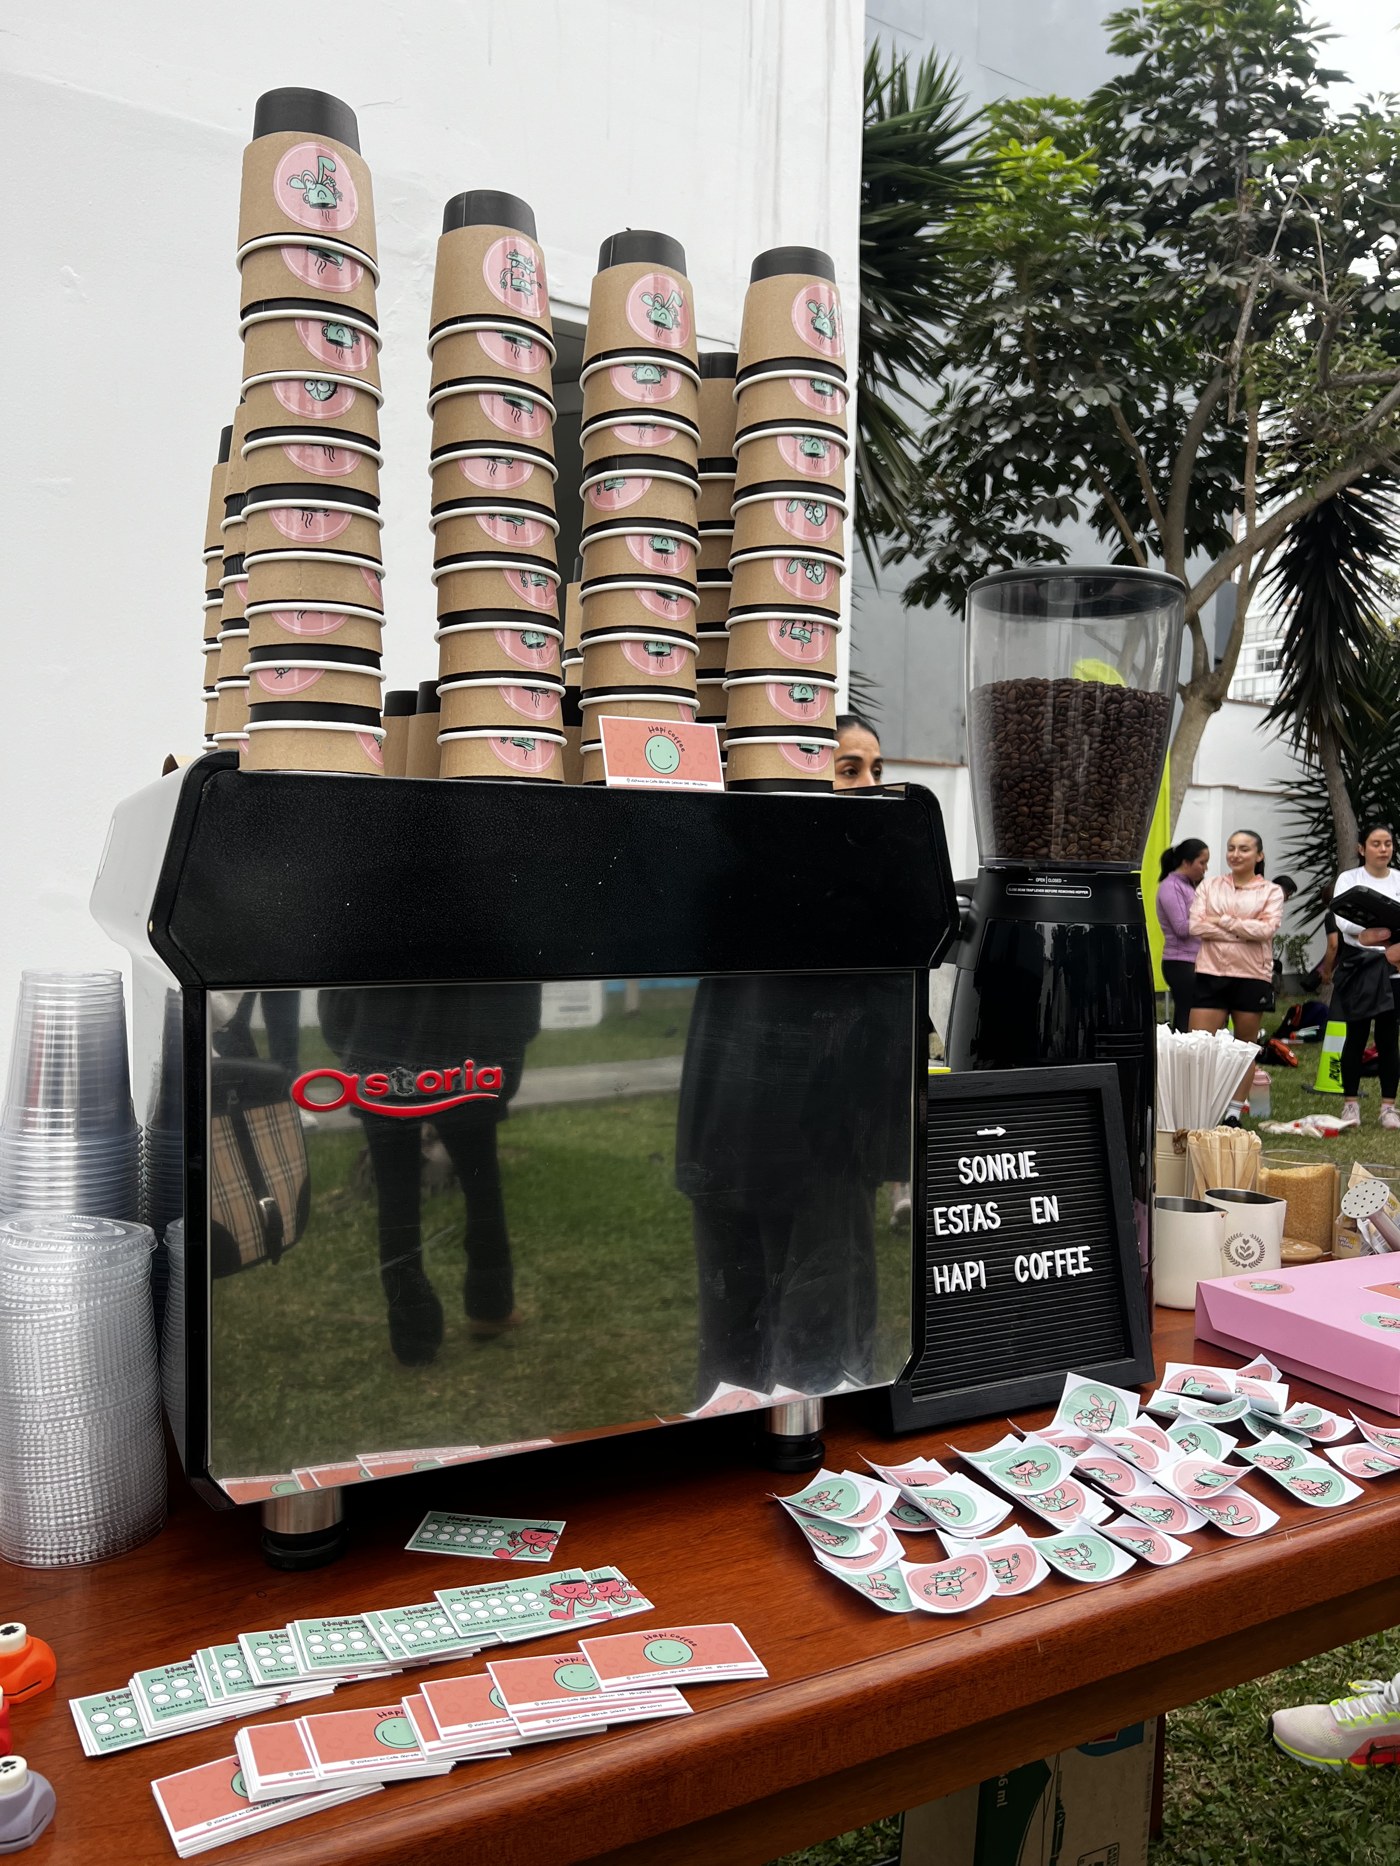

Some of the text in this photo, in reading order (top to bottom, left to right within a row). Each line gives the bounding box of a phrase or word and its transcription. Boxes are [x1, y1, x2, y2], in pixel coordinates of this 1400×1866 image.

[648, 726, 685, 752] Hapi coffee
[958, 1150, 1040, 1184] SONRIE
[933, 1195, 1060, 1236] ESTAS EN
[932, 1246, 1093, 1294] HAPI COFFEE
[518, 1611, 544, 1619] GRATIS
[670, 1634, 697, 1646] coffee
[376, 1709, 403, 1718] Hapi
[996, 1773, 1008, 1808] 6 ml
